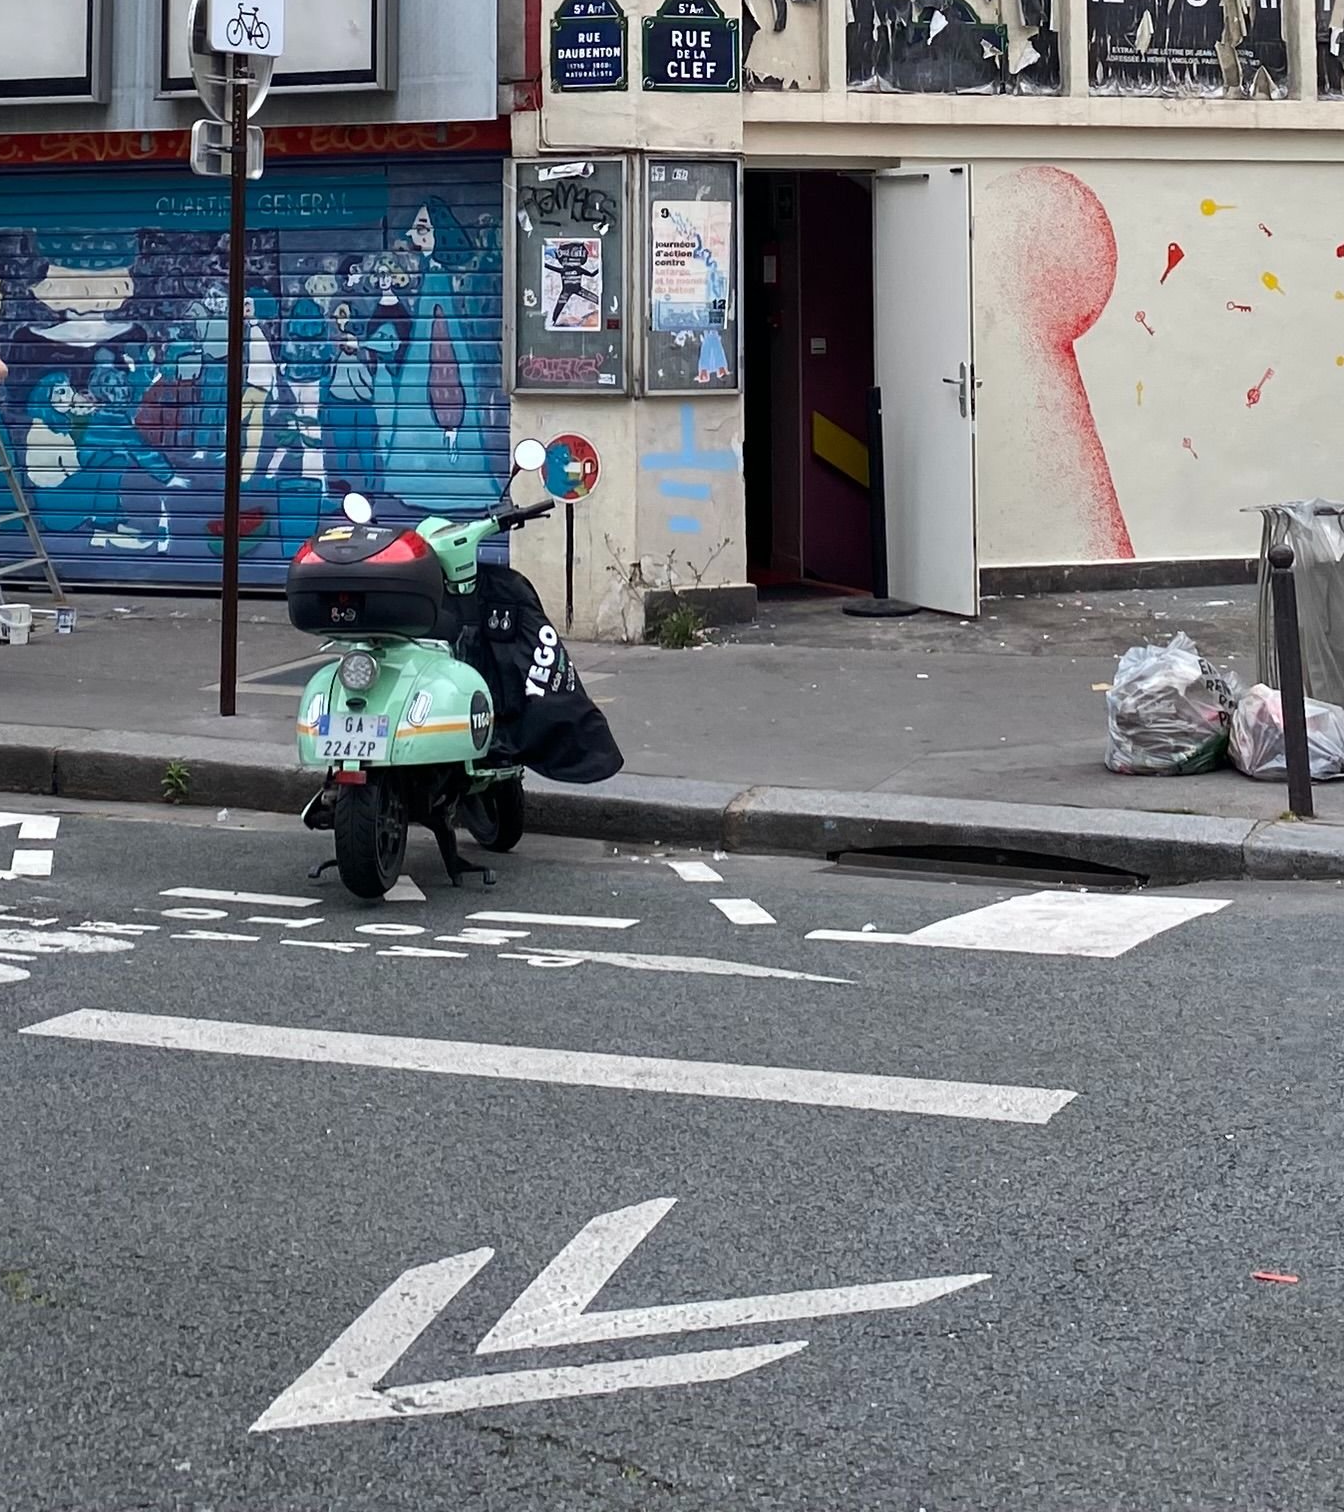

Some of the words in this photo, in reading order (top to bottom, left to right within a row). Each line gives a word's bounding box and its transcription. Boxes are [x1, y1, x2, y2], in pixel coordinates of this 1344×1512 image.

[578, 32, 601, 43] RUE
[671, 30, 712, 49] RUE
[557, 46, 622, 60] DAUBENTON
[676, 49, 691, 60] DE
[693, 49, 706, 60] LA
[666, 61, 717, 79] CLEF
[660, 208, 670, 219] 9
[654, 241, 696, 250] journées
[654, 250, 693, 258] d'action
[654, 258, 686, 267] contre
[711, 299, 726, 310] 12
[525, 624, 558, 697] YEGO
